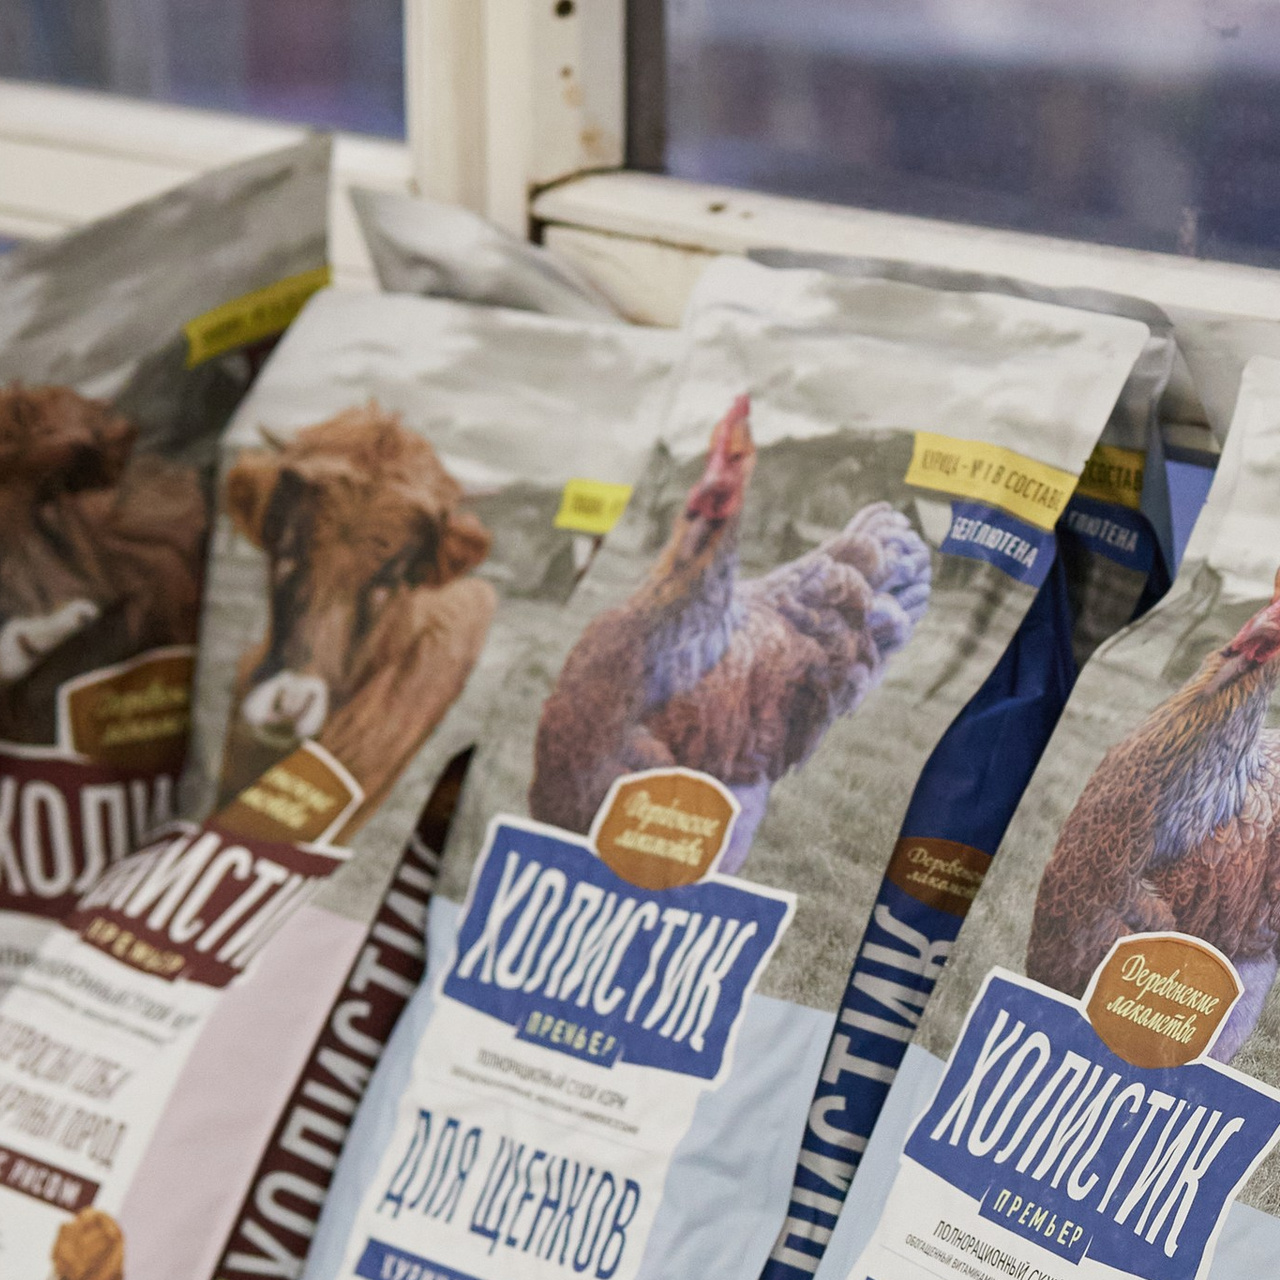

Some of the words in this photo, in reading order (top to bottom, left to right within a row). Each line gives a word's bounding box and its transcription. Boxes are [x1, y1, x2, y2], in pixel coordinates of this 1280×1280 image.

[457, 850, 758, 1053] ХОЛИСТИК
[1122, 953, 1221, 1016] Деревенские
[1105, 993, 1197, 1046] лакомства
[930, 1008, 1246, 1259] ХОЛИСТИК
[375, 1108, 482, 1225] ДЛЯ
[992, 1187, 1085, 1249] ПРЕМЬЕР
[905, 1233, 953, 1267] ОБОГАЩЕННЫЙ
